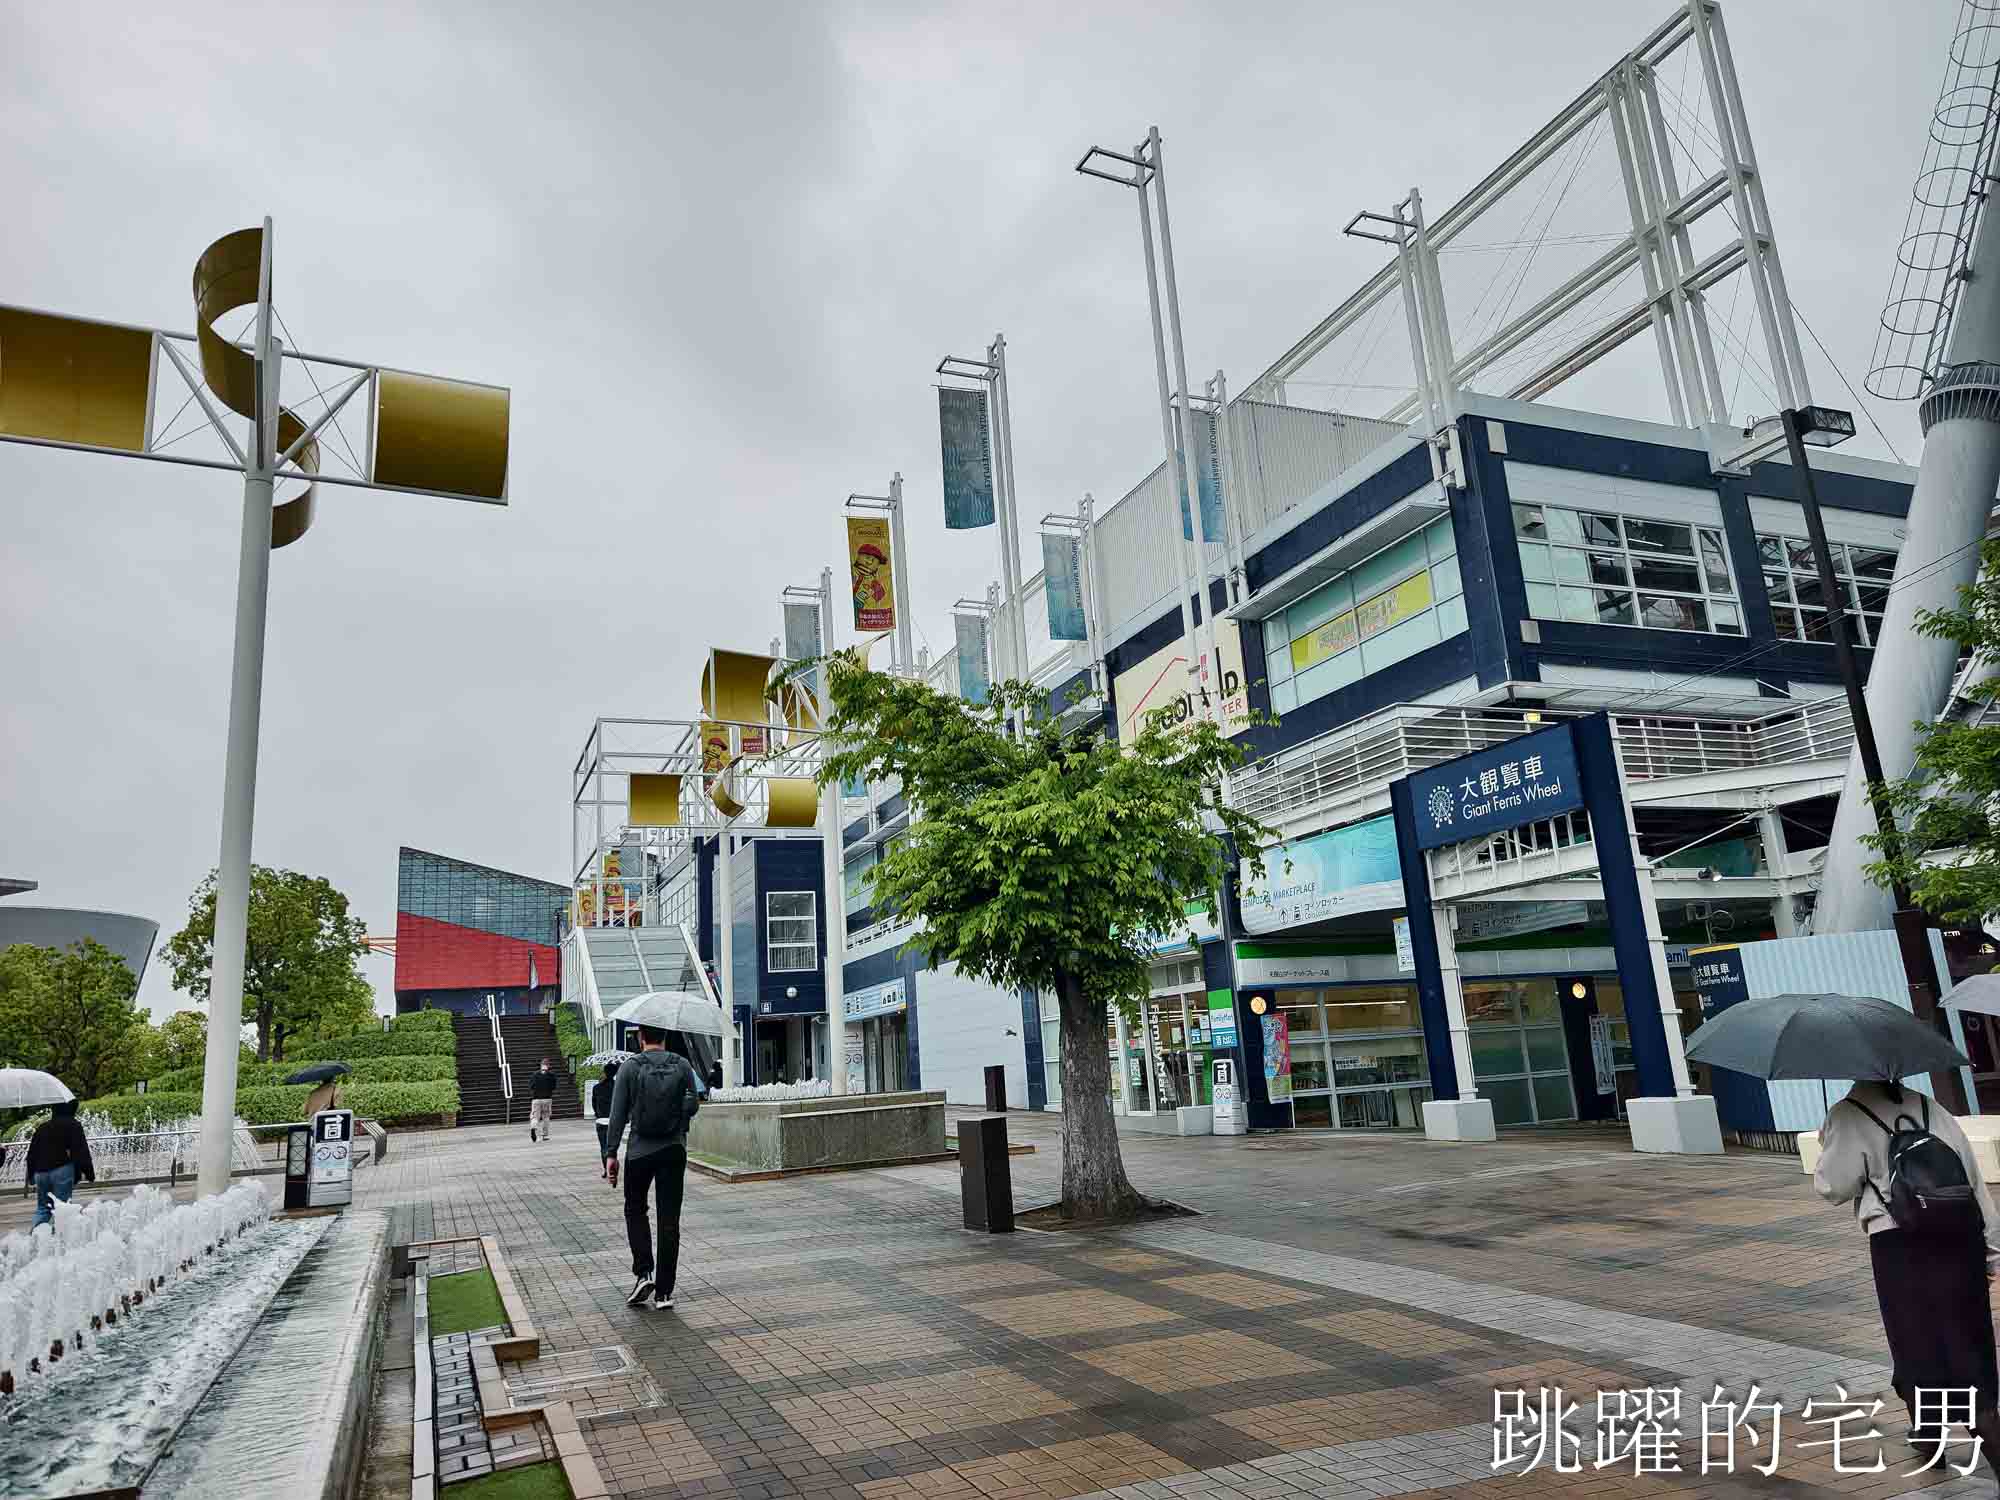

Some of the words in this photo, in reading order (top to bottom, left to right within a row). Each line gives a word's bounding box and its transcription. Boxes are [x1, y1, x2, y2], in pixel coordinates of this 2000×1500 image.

[1458, 755, 1544, 803] 大観覧車
[1462, 801, 1491, 820] Giant
[1493, 792, 1522, 812] Ferris
[1523, 776, 1562, 802] Wheel
[1273, 882, 1316, 901] MARKETPLACE
[1150, 1003, 1169, 1105] FamilyMart
